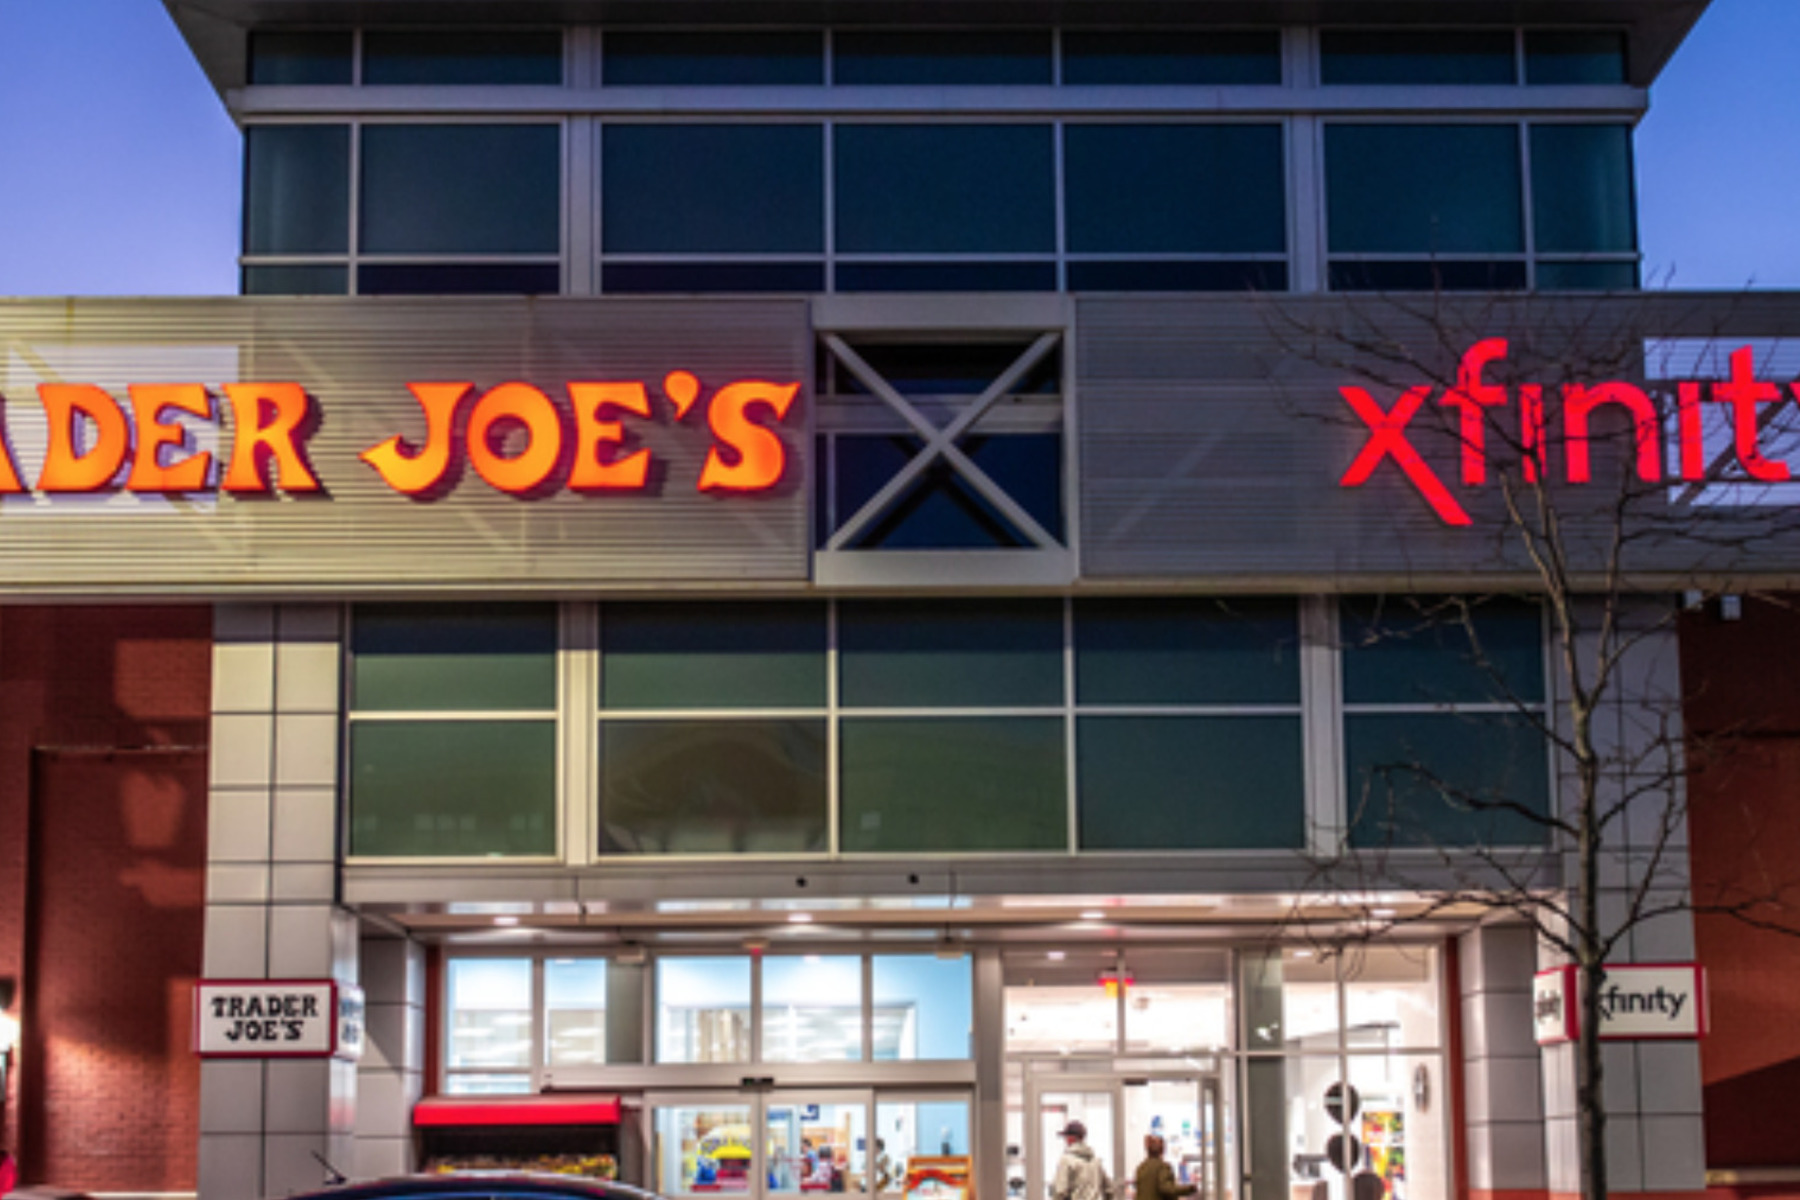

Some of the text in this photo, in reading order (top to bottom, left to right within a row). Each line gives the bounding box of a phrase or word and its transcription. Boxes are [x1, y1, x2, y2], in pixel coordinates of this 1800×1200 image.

[0, 370, 800, 491] DER JOE'S
[1339, 337, 1800, 525] xfinit
[211, 995, 318, 1017] TRADER
[225, 1020, 304, 1041] JOE'S
